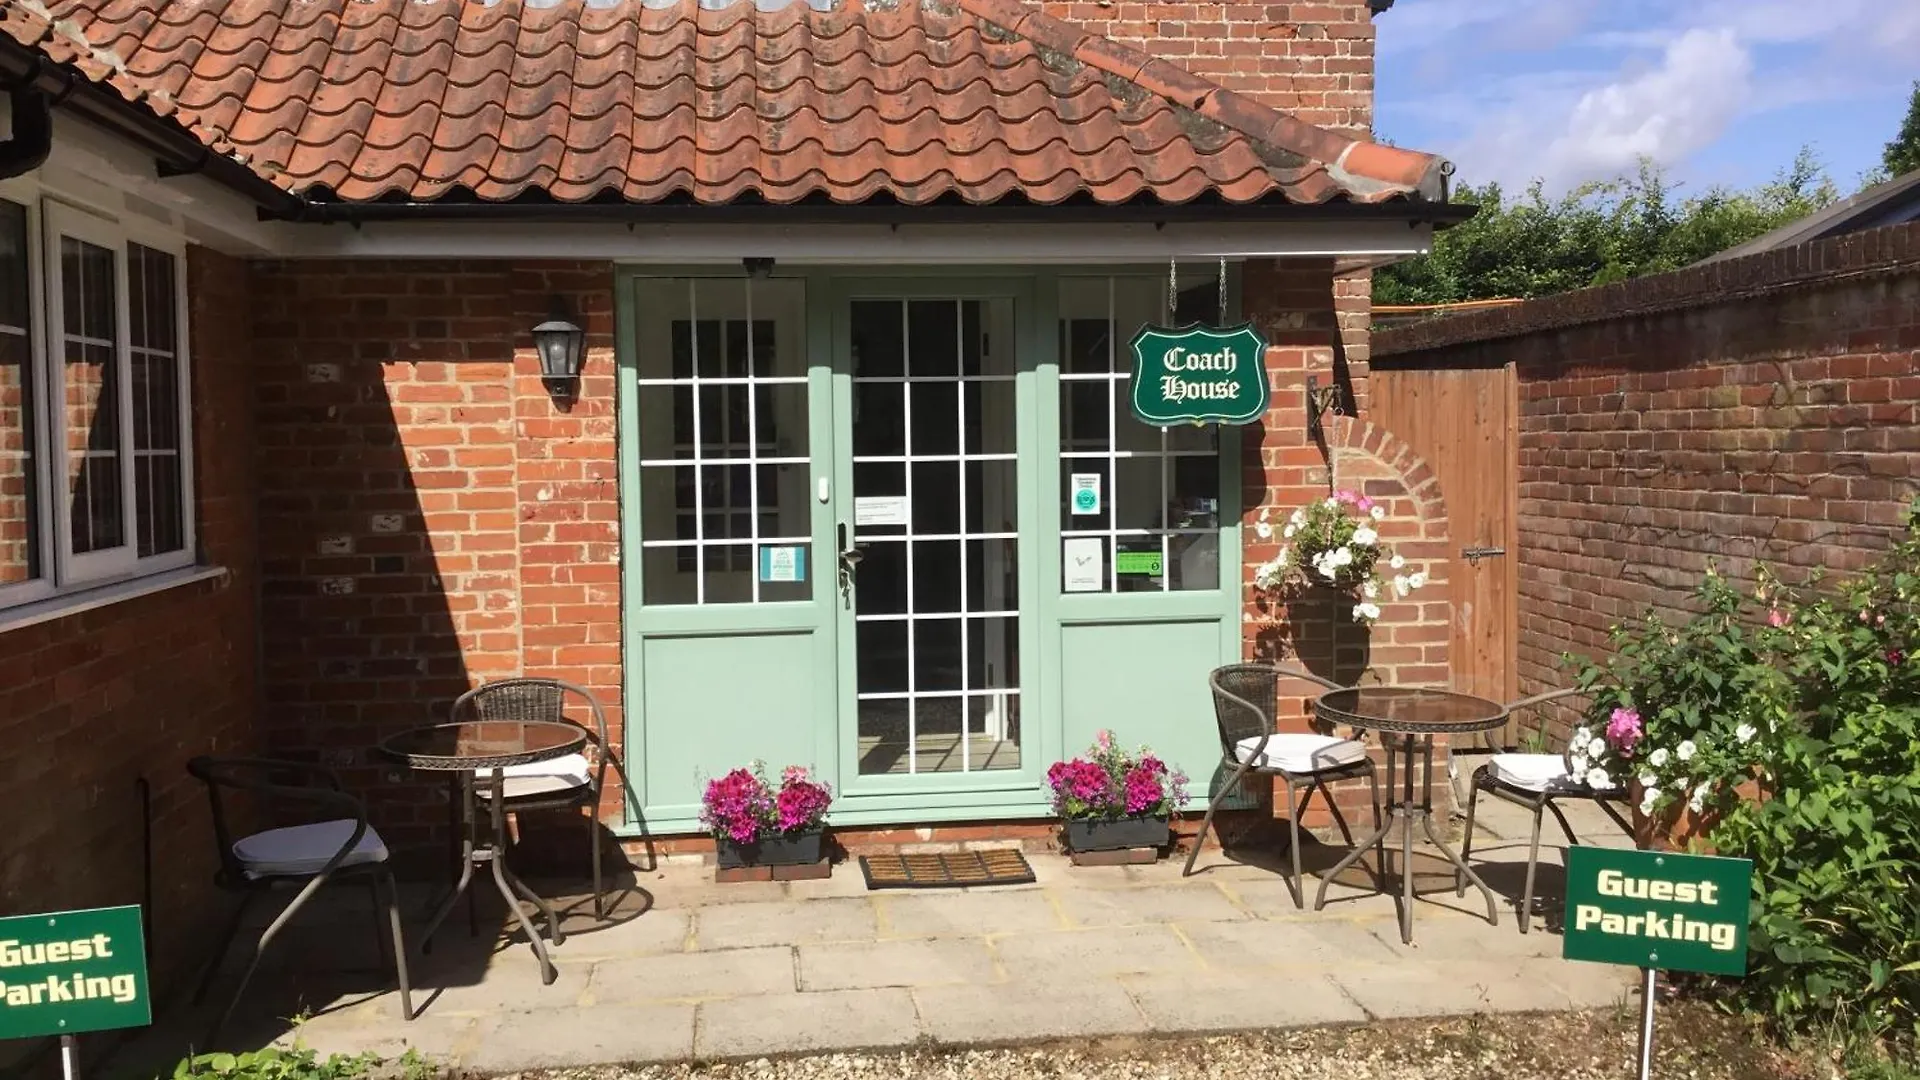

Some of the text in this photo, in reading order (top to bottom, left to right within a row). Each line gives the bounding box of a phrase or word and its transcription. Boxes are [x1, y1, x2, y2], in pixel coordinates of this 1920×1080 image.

[1163, 346, 1237, 374] Coach
[1159, 375, 1241, 404] House
[1597, 869, 1718, 905] Guest
[1575, 904, 1737, 950] Parking
[0, 933, 113, 967] Guest
[0, 972, 136, 1006] arking
